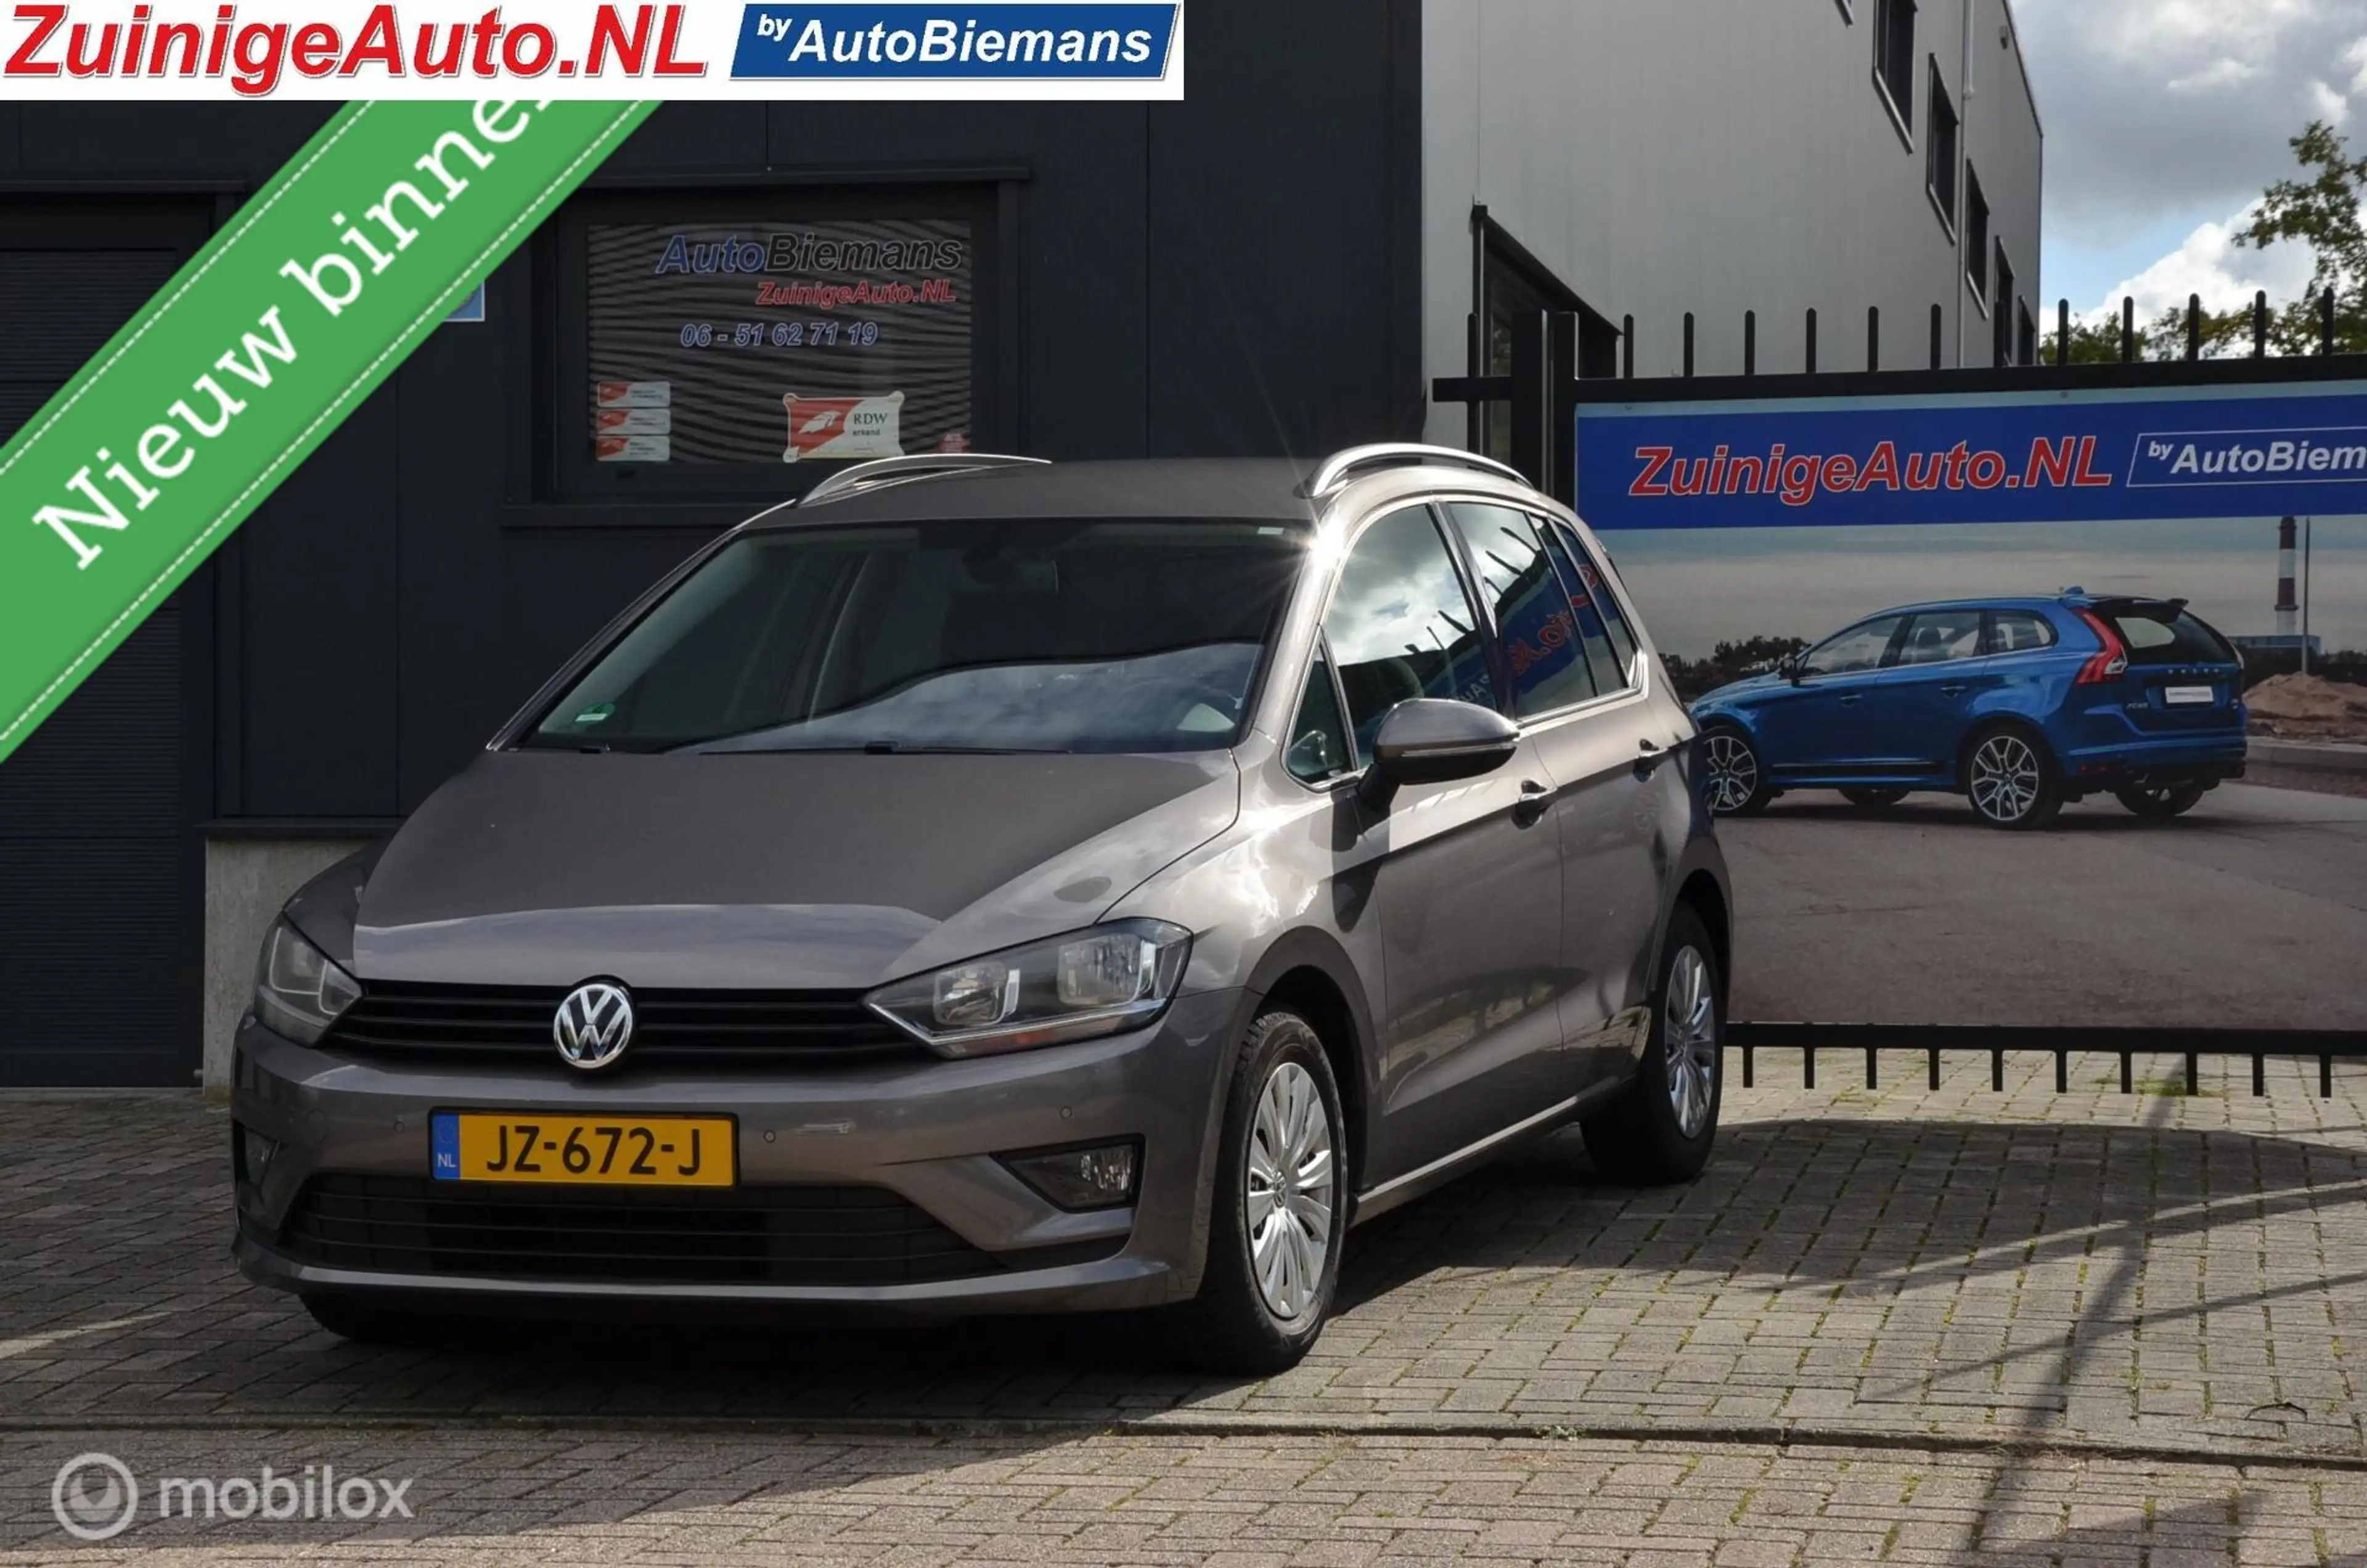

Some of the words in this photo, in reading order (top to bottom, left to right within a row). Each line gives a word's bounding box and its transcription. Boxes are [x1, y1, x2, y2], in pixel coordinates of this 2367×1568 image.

[655, 234, 962, 274] AutoBiemans
[756, 279, 957, 309] ZuinigeAuto.NL
[681, 325, 713, 347] 06
[735, 324, 764, 346] 51
[772, 323, 802, 346] 62
[811, 322, 840, 345] 71
[849, 322, 878, 345] 19
[853, 413, 888, 425] RDW
[2148, 441, 2174, 460] by
[1629, 435, 2112, 507] ZuinigeAuto.NL
[438, 1153, 456, 1167] NL
[486, 1125, 701, 1176] JZ-672-J
